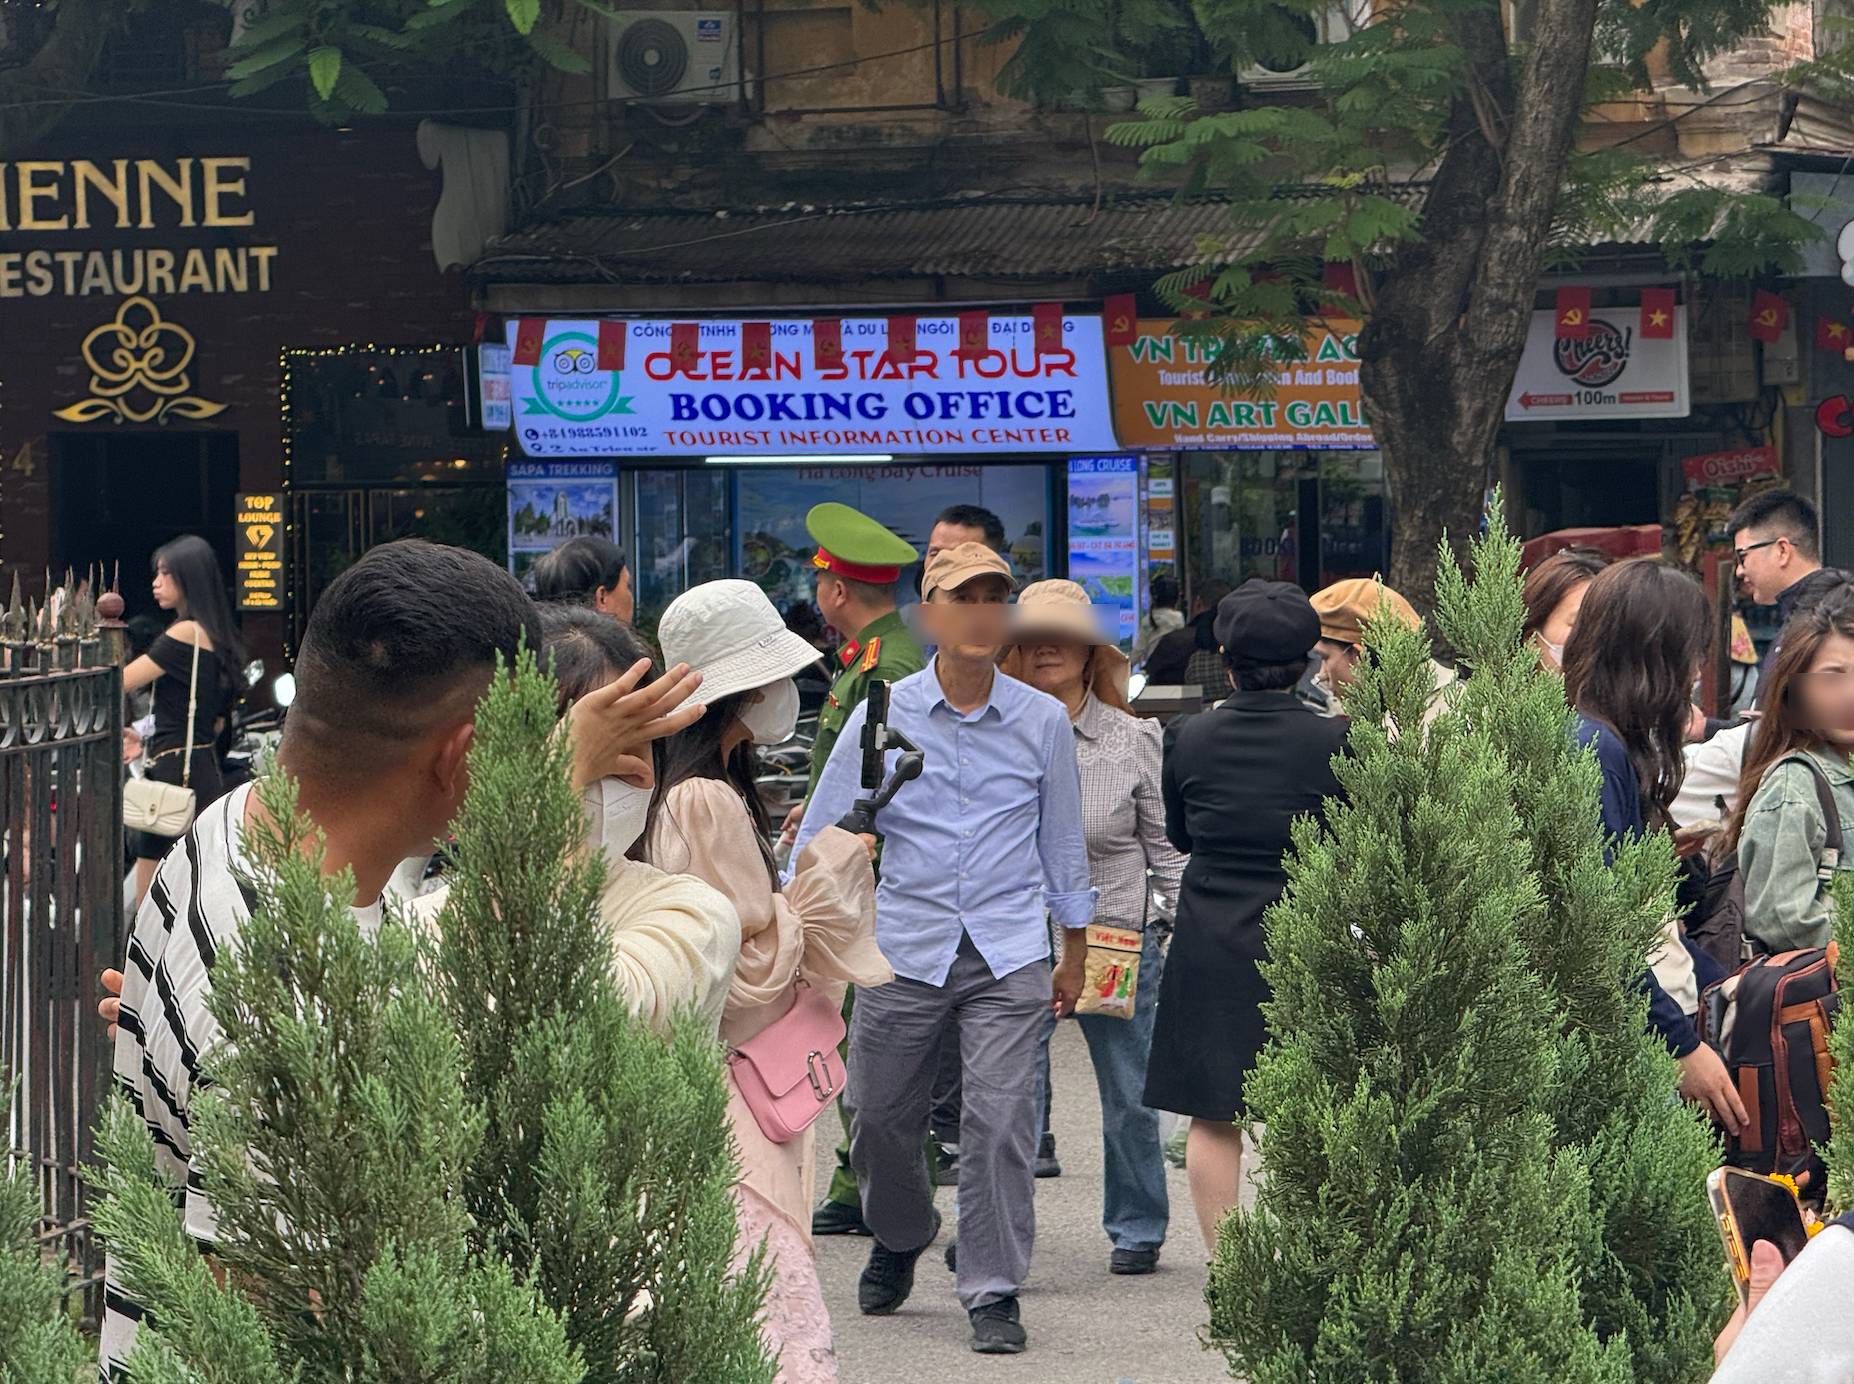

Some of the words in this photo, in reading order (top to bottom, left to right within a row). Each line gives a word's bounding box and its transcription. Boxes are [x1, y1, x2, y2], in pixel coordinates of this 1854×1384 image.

[0, 247, 278, 297] ESTAURANT
[700, 325, 736, 337] TNHH
[858, 324, 876, 335] DU
[1128, 335, 1174, 363] VN
[950, 348, 1078, 379] TOUR
[1158, 369, 1204, 386] Tourist
[1295, 369, 1322, 385] And
[668, 391, 888, 421] BOOKING
[904, 389, 1076, 420] OFFICE
[1574, 390, 1616, 405] 100m
[1144, 401, 1197, 429] VN
[1206, 401, 1278, 429] ART
[663, 430, 778, 446] TOURIST
[780, 428, 964, 446] INFORMATION
[972, 427, 1072, 444] CENTER
[510, 463, 545, 476] SAPA
[548, 462, 613, 475] TREKKING
[1097, 458, 1132, 472] CRUISE
[1702, 456, 1756, 479] Oishi
[245, 496, 274, 511] TOP
